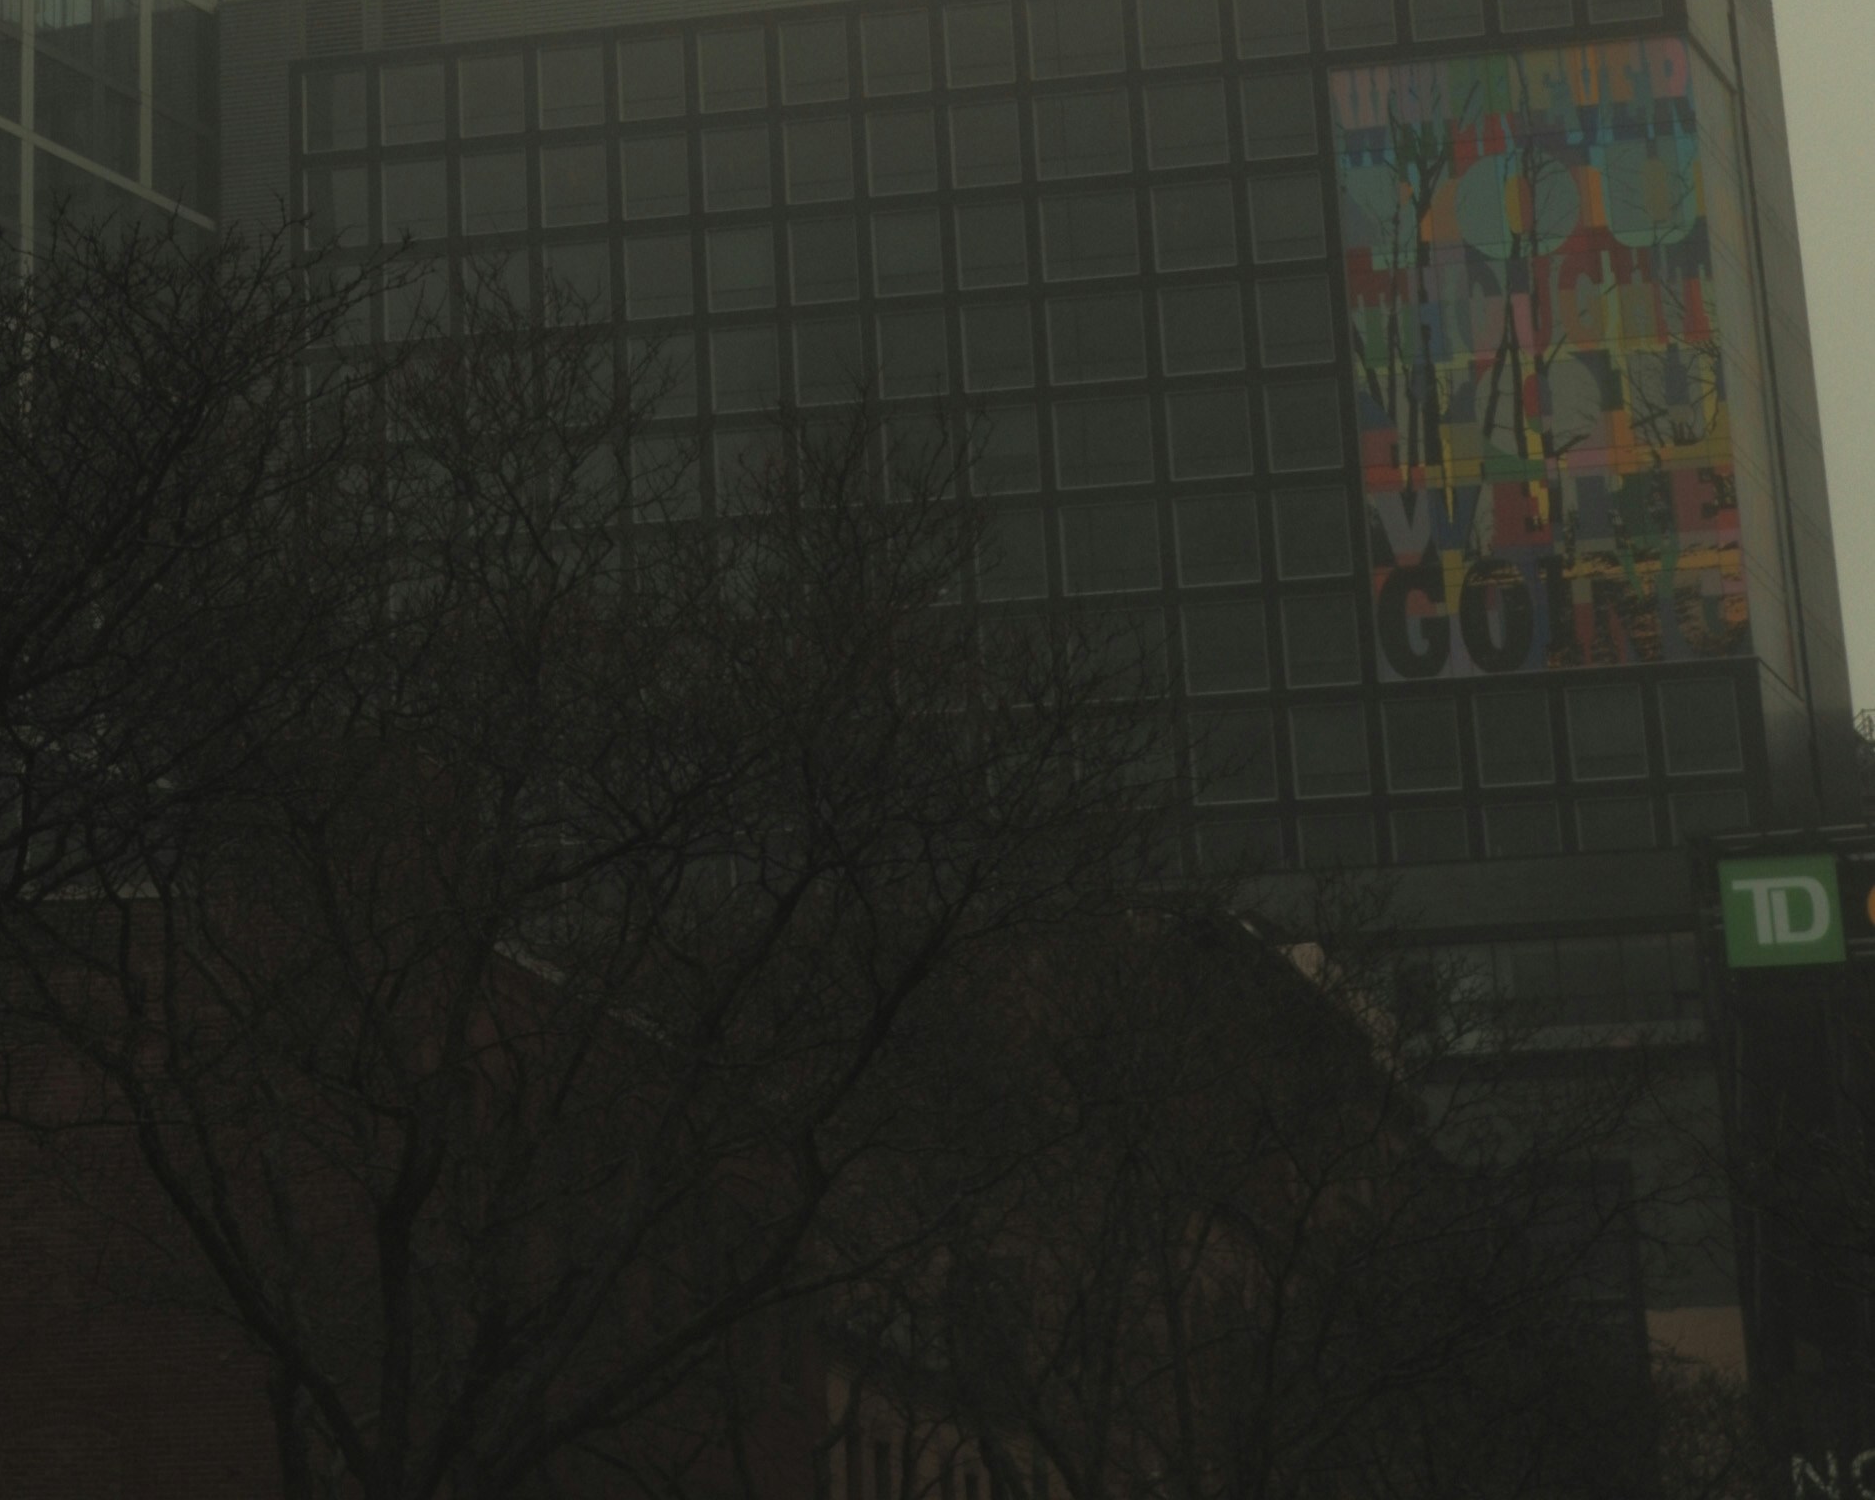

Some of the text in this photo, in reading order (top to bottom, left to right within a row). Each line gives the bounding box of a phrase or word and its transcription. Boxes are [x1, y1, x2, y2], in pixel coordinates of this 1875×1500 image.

[1344, 135, 1698, 271] YOU
[1347, 246, 1716, 368] THOUGHT
[1377, 550, 1752, 679] GOING
[1731, 876, 1830, 945] TD
